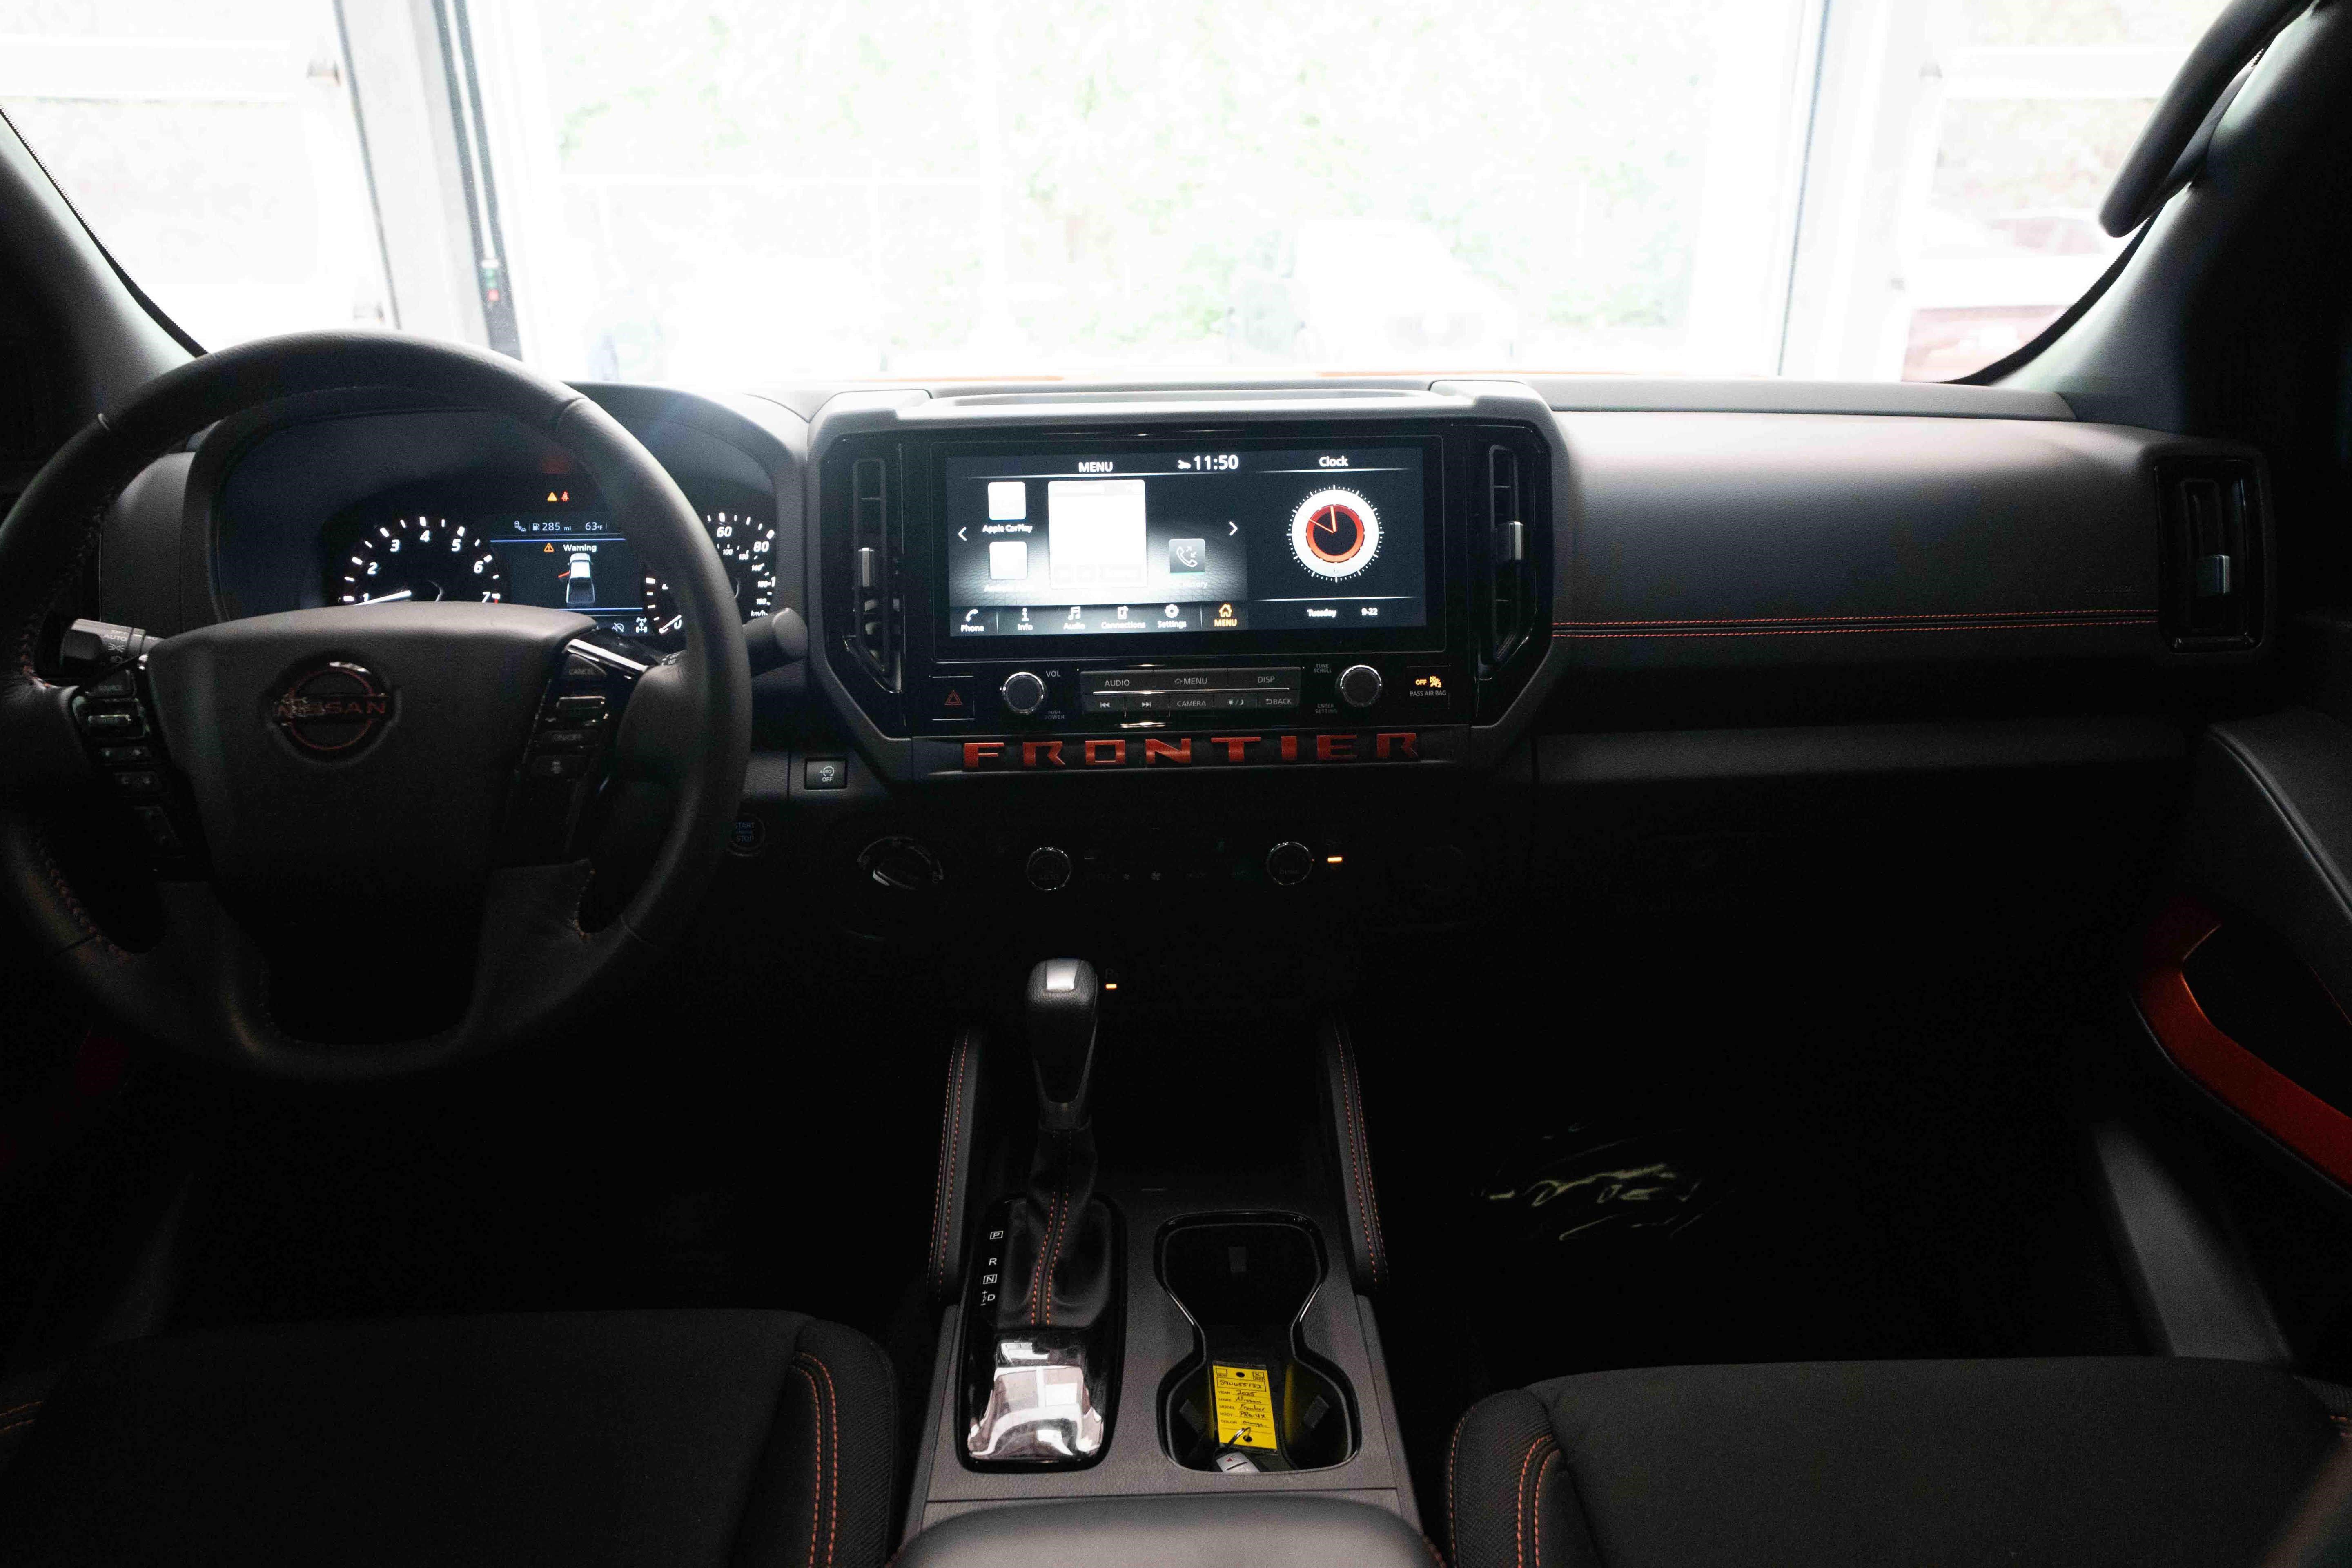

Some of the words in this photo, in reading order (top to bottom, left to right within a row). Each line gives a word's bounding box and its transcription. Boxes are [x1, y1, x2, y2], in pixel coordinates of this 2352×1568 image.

[1078, 461, 1113, 473] MENU
[1194, 454, 1239, 470] 11:50
[1319, 456, 1349, 467] Clock
[542, 522, 560, 531] 285
[717, 526, 732, 538] 60
[982, 524, 1005, 534] Apple
[420, 530, 430, 543] 4
[390, 539, 401, 552] 3
[452, 539, 461, 552] 5
[563, 544, 597, 552] Warning
[753, 541, 769, 552] 80
[368, 562, 378, 575] 2
[474, 561, 483, 573] 6
[482, 591, 491, 603] 7
[960, 624, 984, 632] Phone
[1018, 623, 1033, 631] Info
[1063, 622, 1086, 630] Audio
[1101, 621, 1146, 629] Connections
[1157, 619, 1187, 629] Settings
[1214, 619, 1238, 627] MENU
[1183, 677, 1208, 685] MENU
[962, 733, 1419, 768] FRONTIER
[989, 1258, 997, 1266] R
